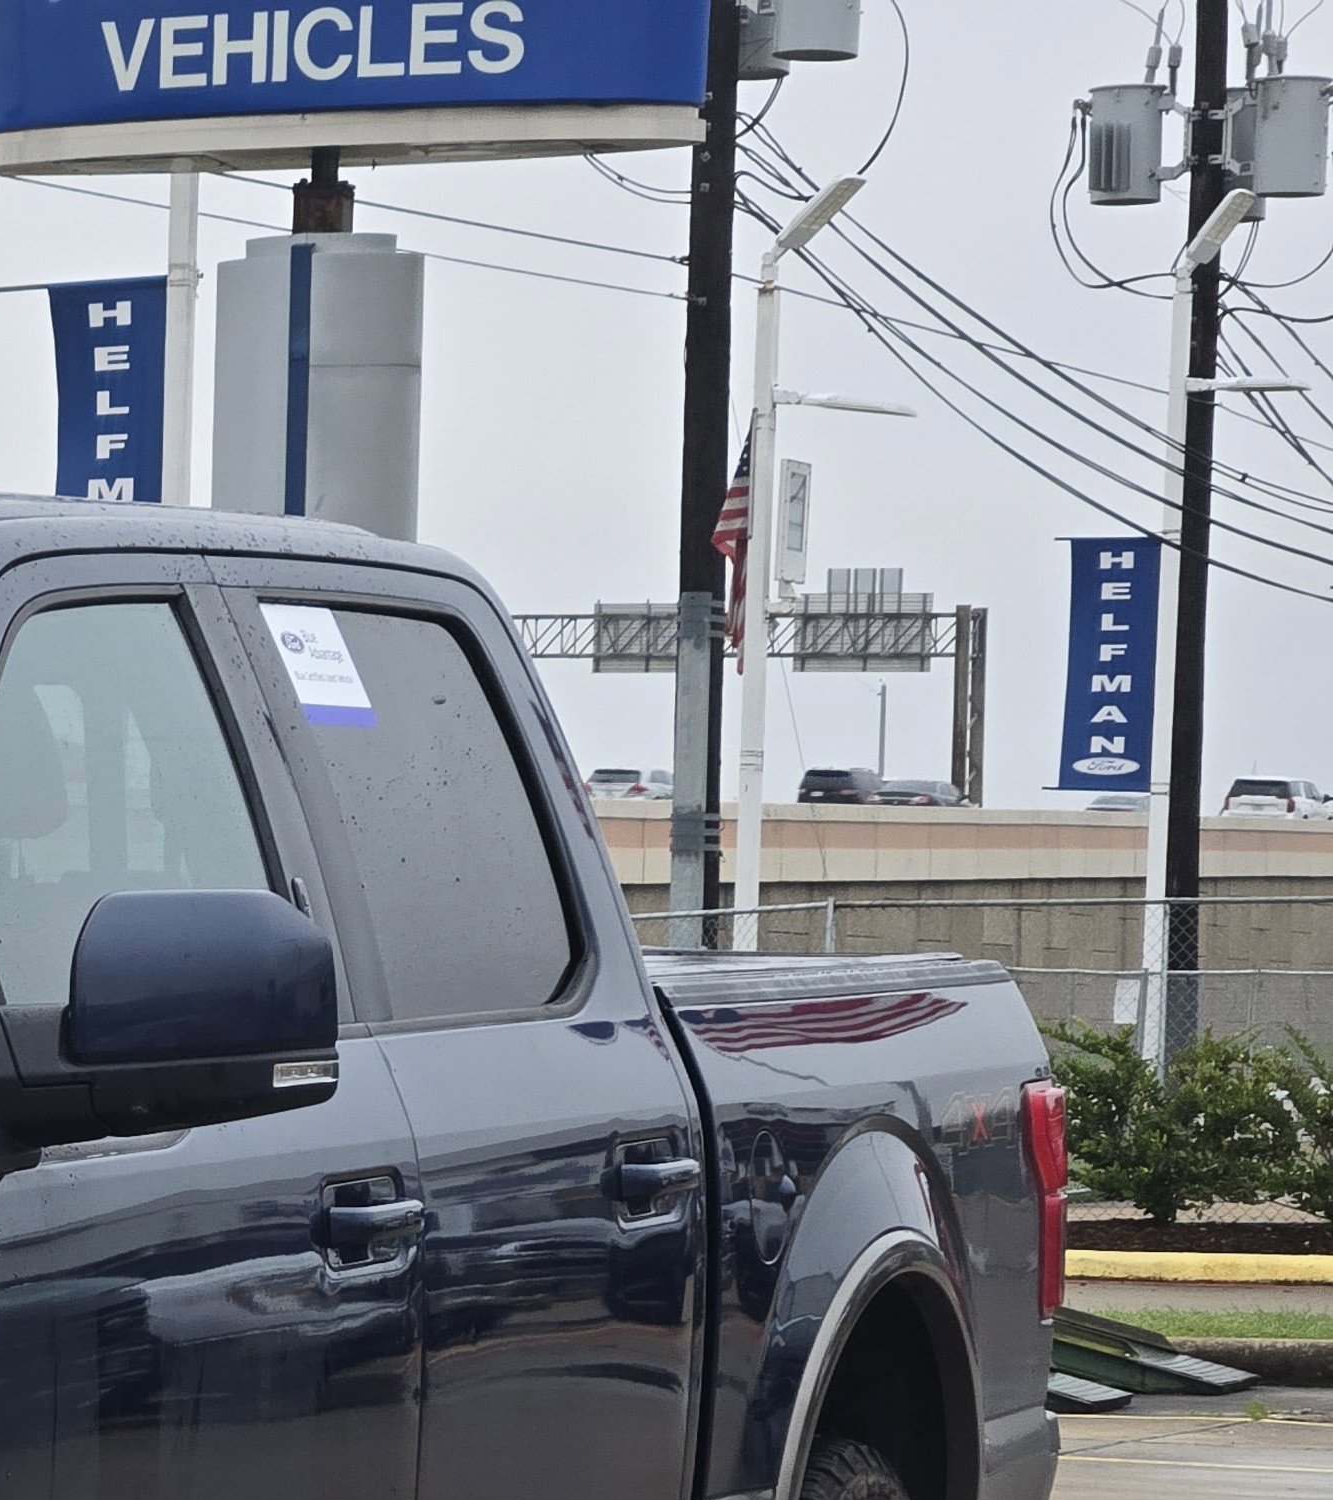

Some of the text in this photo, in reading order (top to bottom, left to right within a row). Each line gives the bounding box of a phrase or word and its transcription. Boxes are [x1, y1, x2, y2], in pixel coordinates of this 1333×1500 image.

[101, 0, 526, 92] VEHICLES
[1090, 551, 1135, 754] HELFMAN
[1086, 760, 1126, 773] Ford
